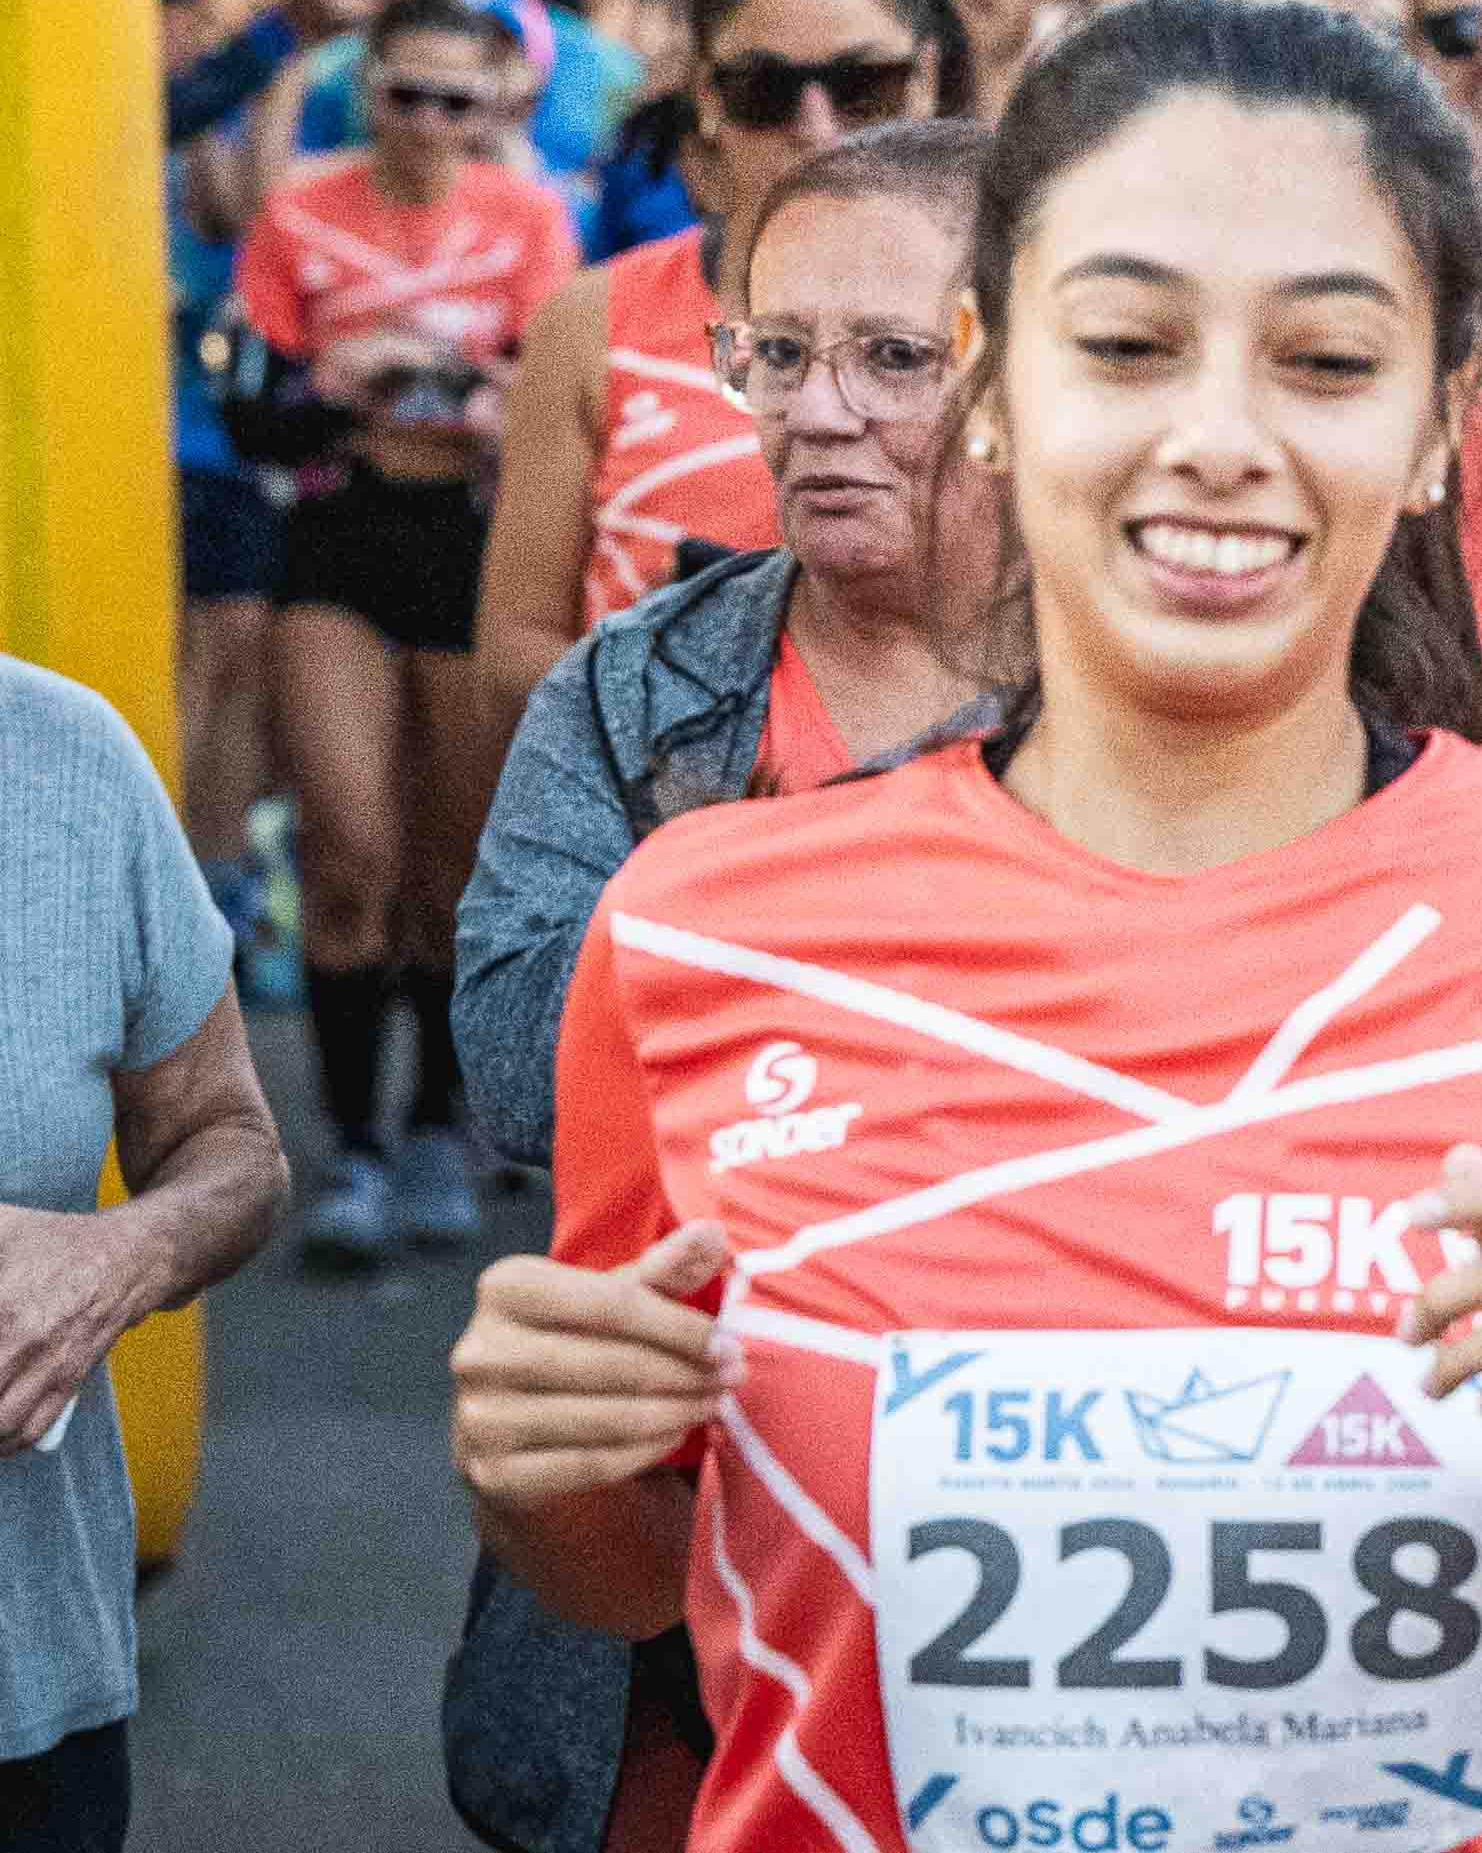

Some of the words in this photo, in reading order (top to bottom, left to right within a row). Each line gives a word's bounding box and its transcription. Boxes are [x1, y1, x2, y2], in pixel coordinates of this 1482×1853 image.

[1213, 1193, 1422, 1293] 15K
[942, 1388, 1105, 1463] 15K
[1320, 1414, 1410, 1460] 15K
[1281, 1707, 1430, 1745] Mariana
[975, 1790, 1173, 1853] osde
